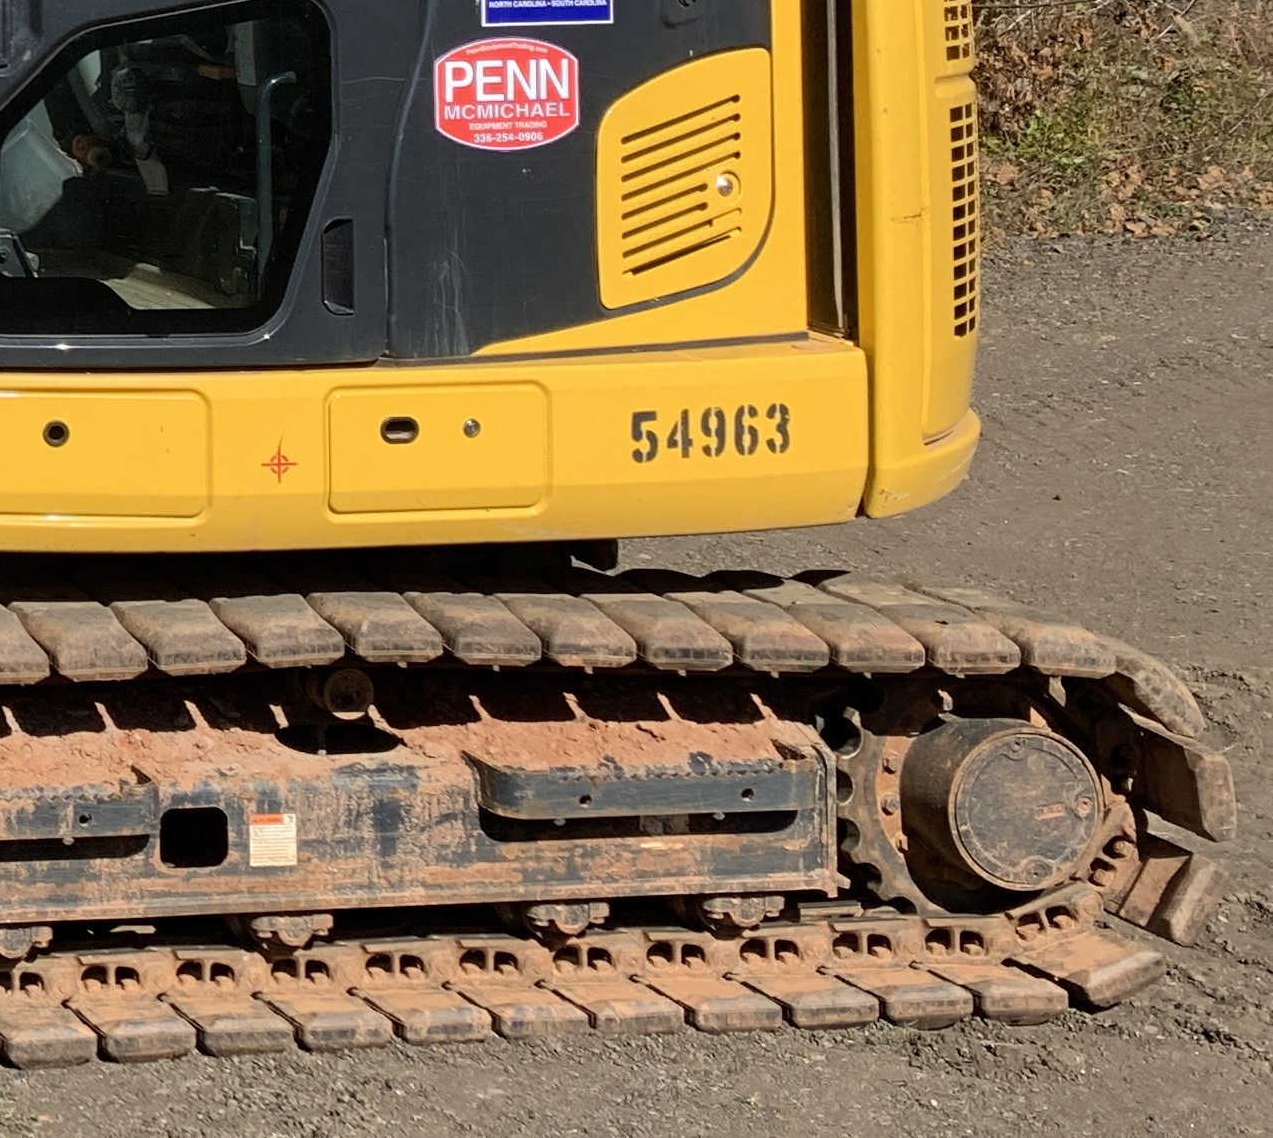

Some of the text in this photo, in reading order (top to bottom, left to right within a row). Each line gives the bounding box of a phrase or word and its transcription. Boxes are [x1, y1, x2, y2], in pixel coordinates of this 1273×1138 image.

[513, 0, 547, 8] CAROLINA
[551, 0, 573, 7] SOUTH
[444, 58, 570, 102] PENN
[444, 102, 571, 120] MCMICHAEL
[469, 120, 548, 131] EQUIPMENT TRADING
[631, 403, 791, 463] 54963
